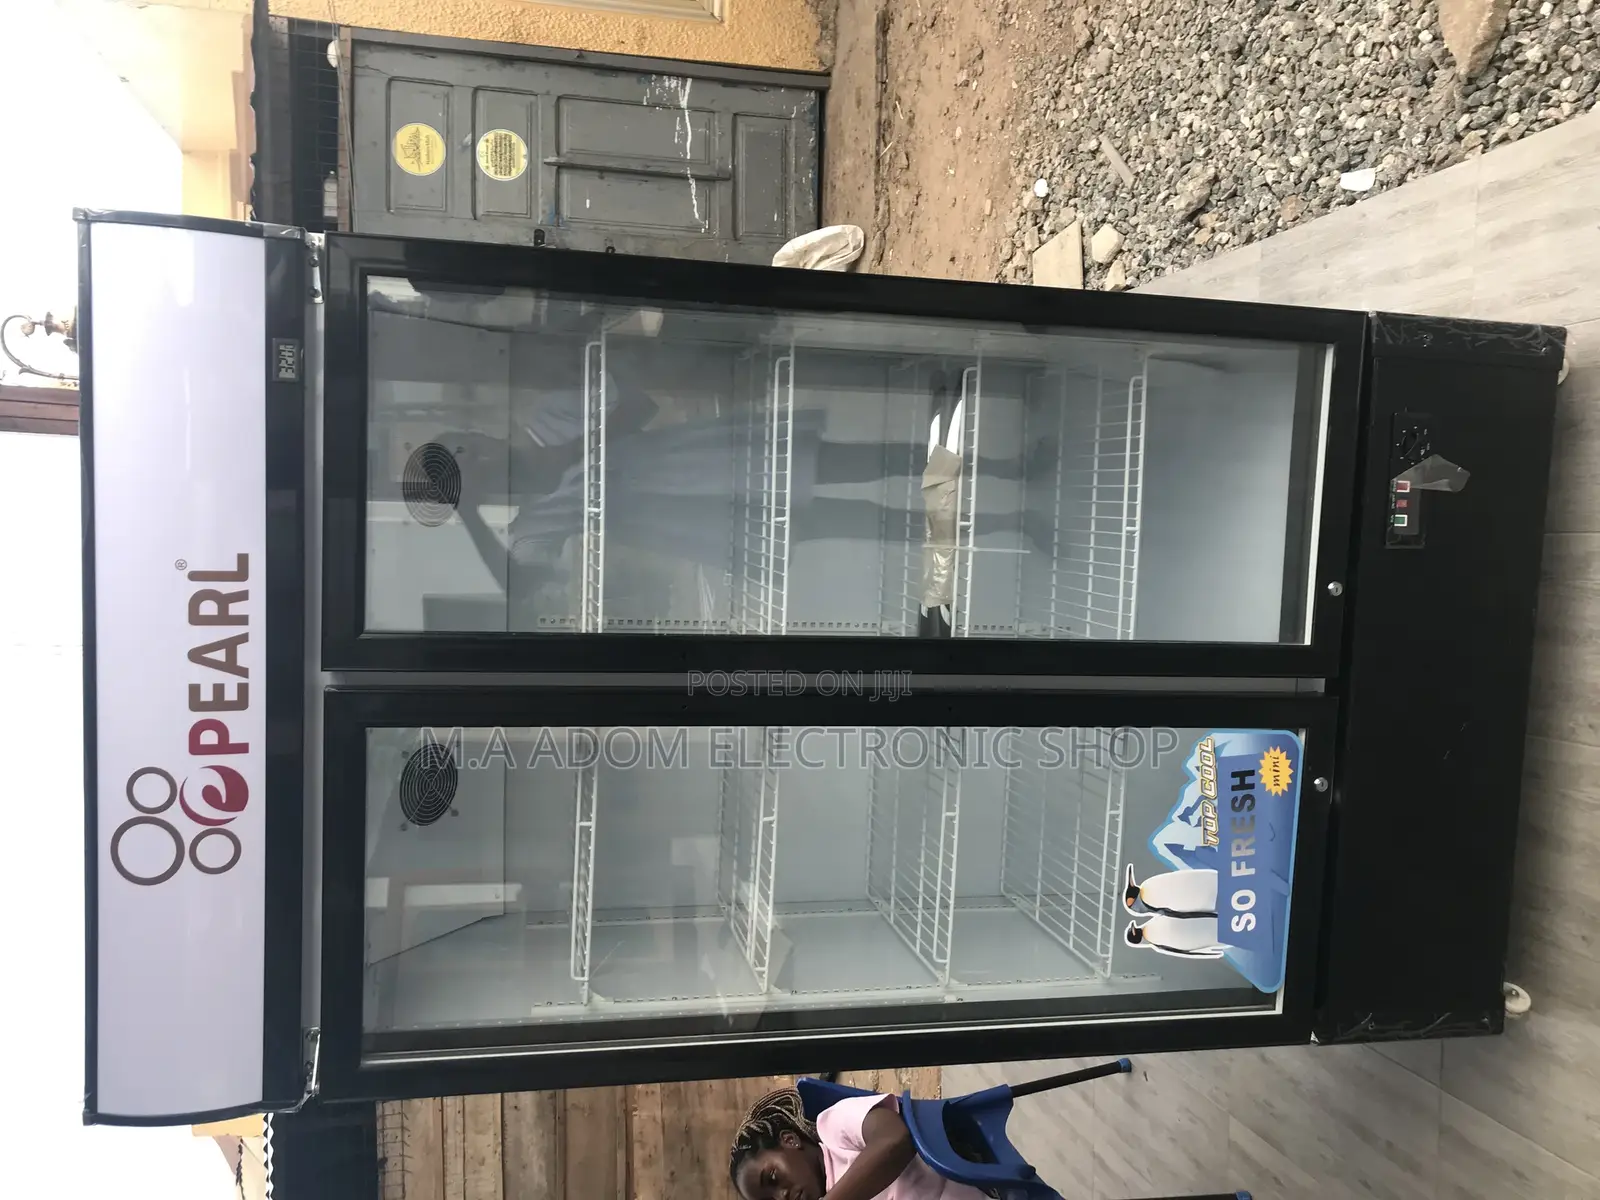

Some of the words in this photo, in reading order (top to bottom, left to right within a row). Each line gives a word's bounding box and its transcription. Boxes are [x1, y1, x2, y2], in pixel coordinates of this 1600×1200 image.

[187, 553, 249, 756] PEARL
[1199, 736, 1218, 800] COOL
[1269, 754, 1281, 788] mini
[1200, 799, 1220, 847] TOP
[1231, 768, 1256, 877] FRESH
[1231, 889, 1256, 932] SO
